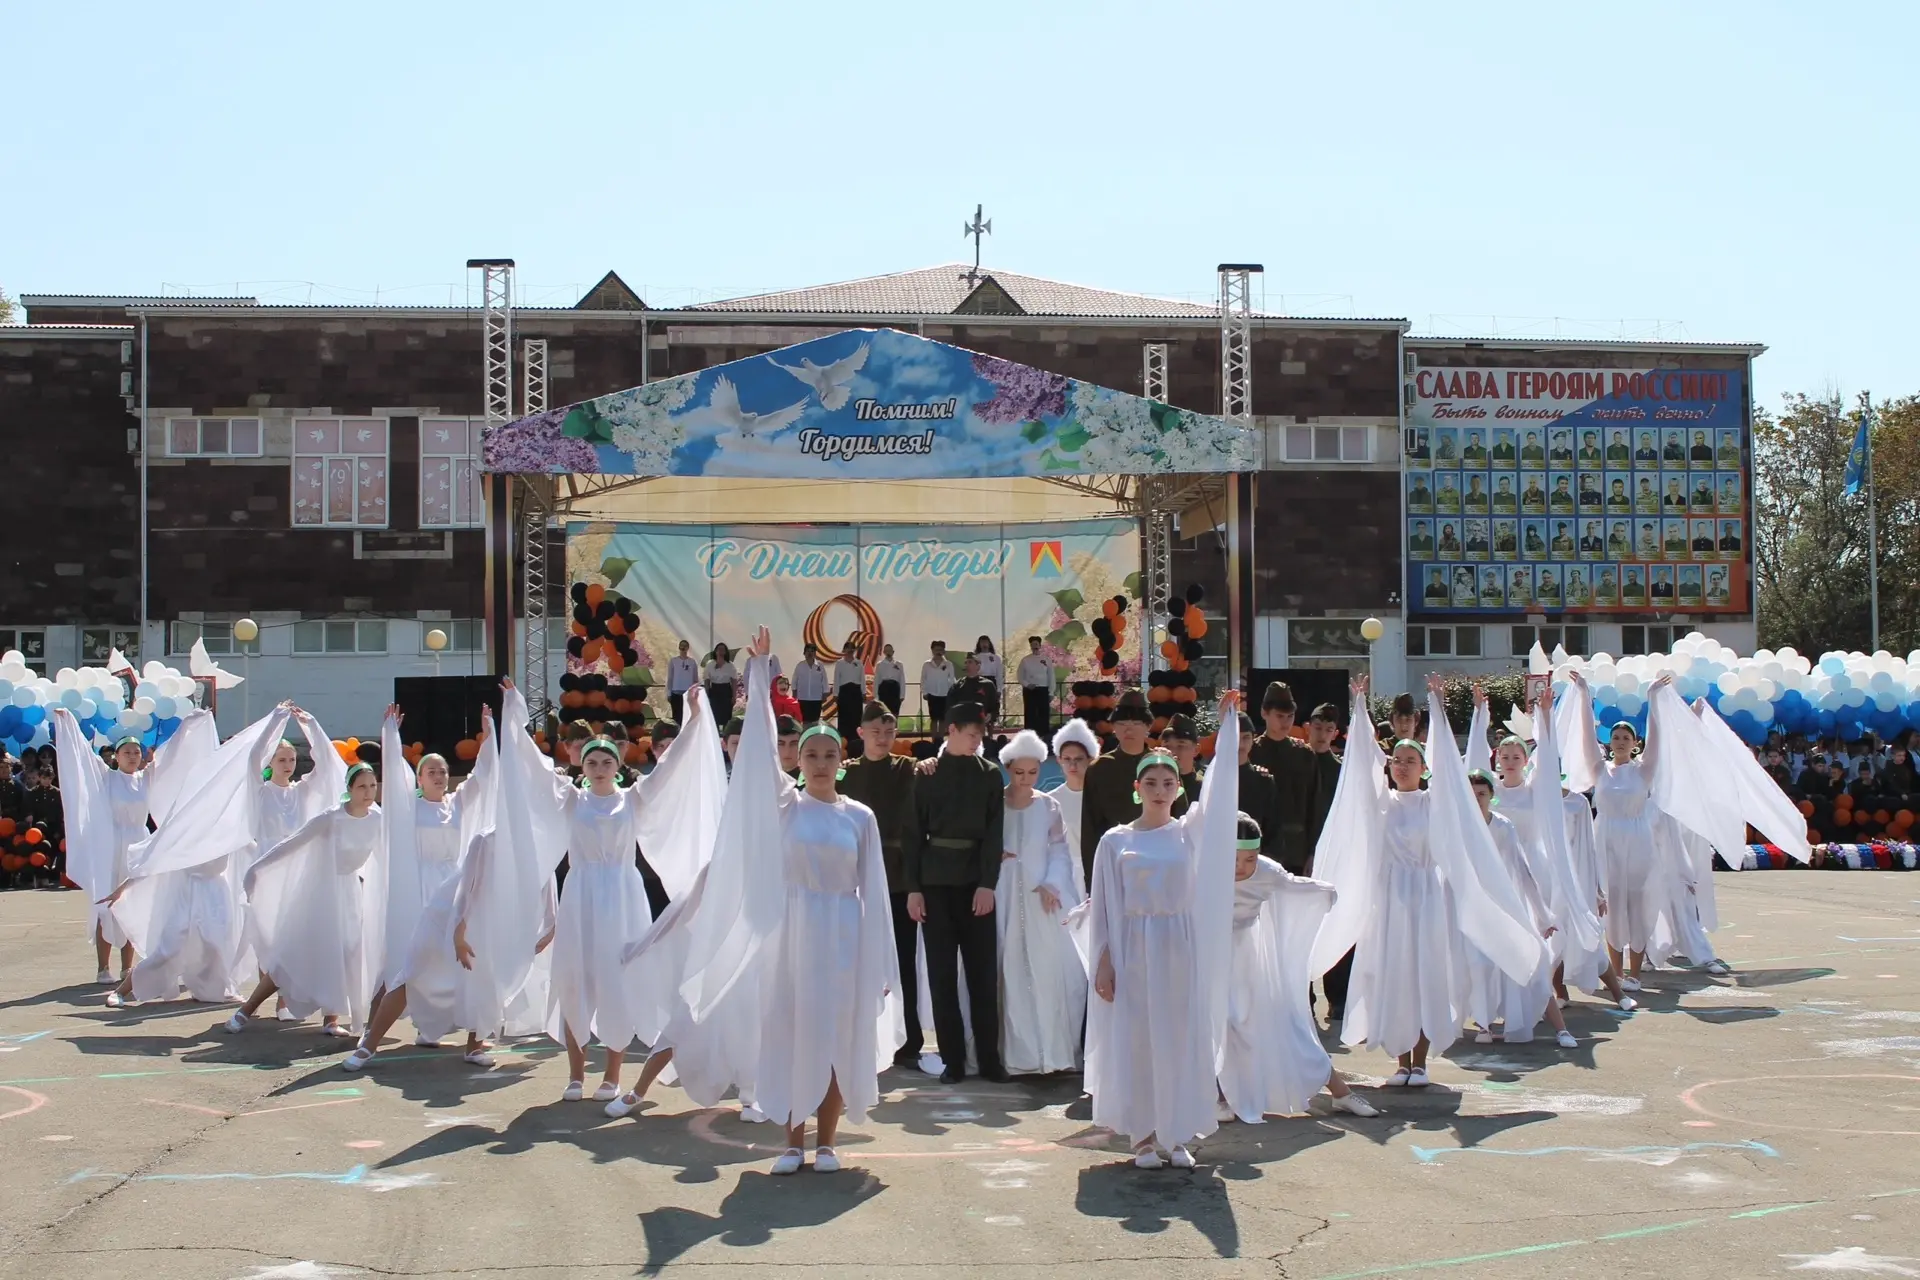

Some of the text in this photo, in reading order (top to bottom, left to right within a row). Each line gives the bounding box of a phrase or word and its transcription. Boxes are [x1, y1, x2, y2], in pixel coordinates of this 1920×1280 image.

[1416, 370, 1729, 402] СЛАВА ГЕРОЯМ РОССИИ!
[855, 398, 956, 420] Помним!
[1431, 402, 1488, 419] Быть
[1494, 404, 1565, 420] воином
[799, 428, 935, 461] Гордимся!
[697, 539, 1012, 590] С Днем Победы!
